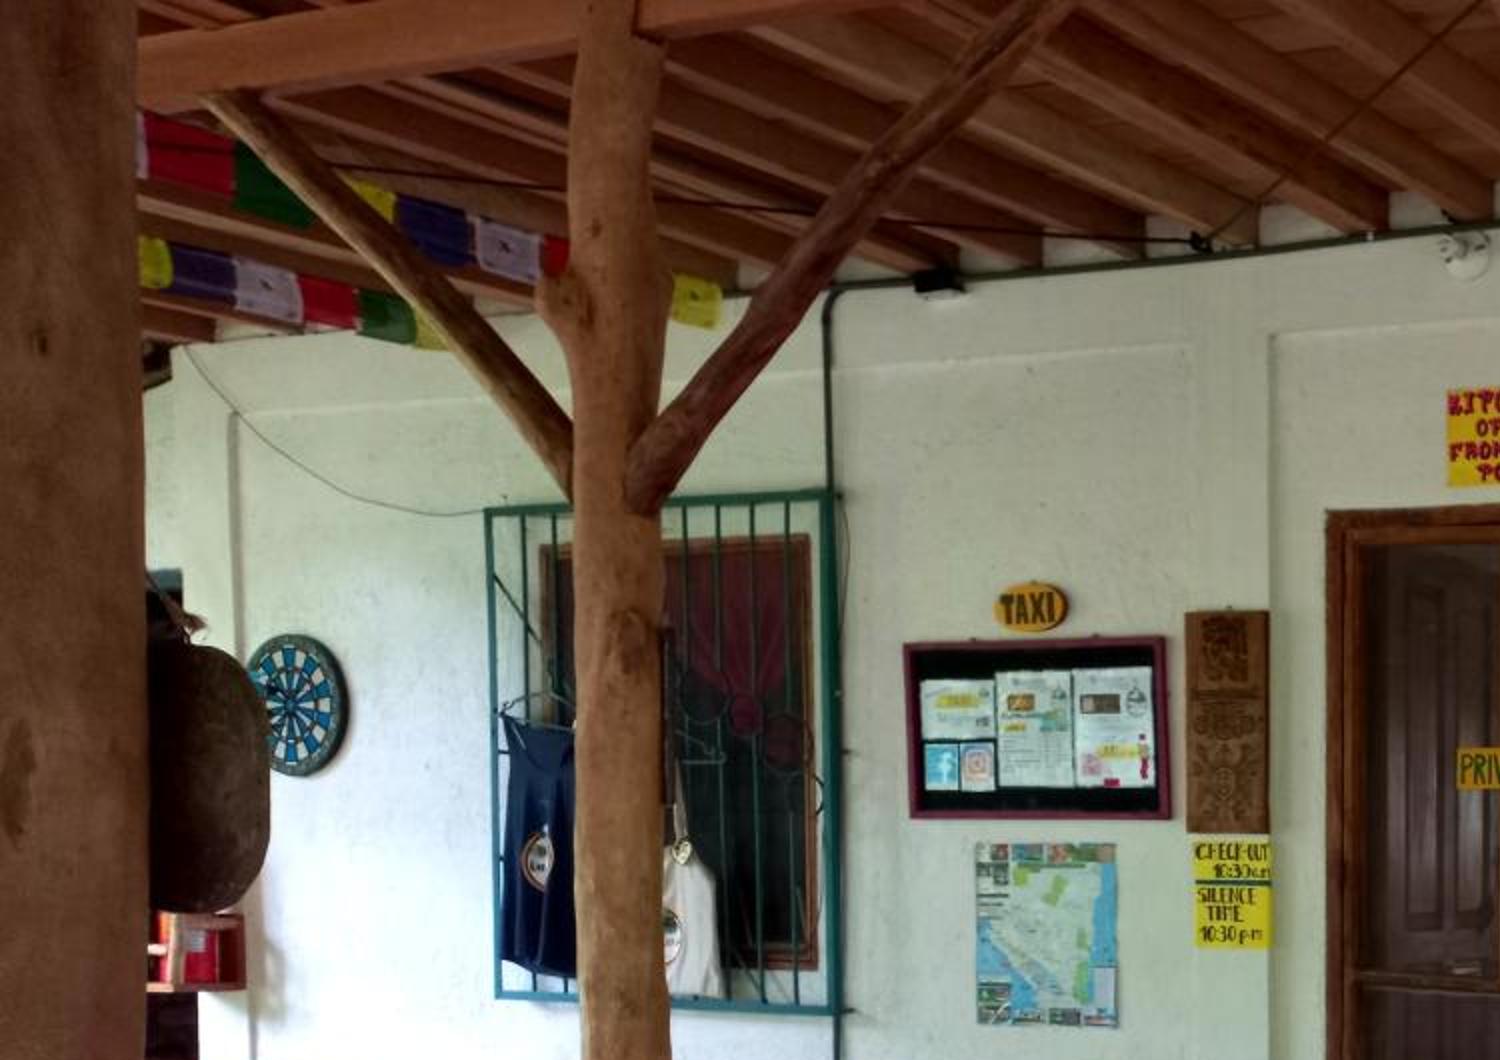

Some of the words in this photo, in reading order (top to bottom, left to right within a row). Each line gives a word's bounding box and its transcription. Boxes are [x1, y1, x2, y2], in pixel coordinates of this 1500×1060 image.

[999, 591, 1055, 625] TAXI
[1197, 888, 1255, 905] SILENCE
[1206, 905, 1244, 923] TIME
